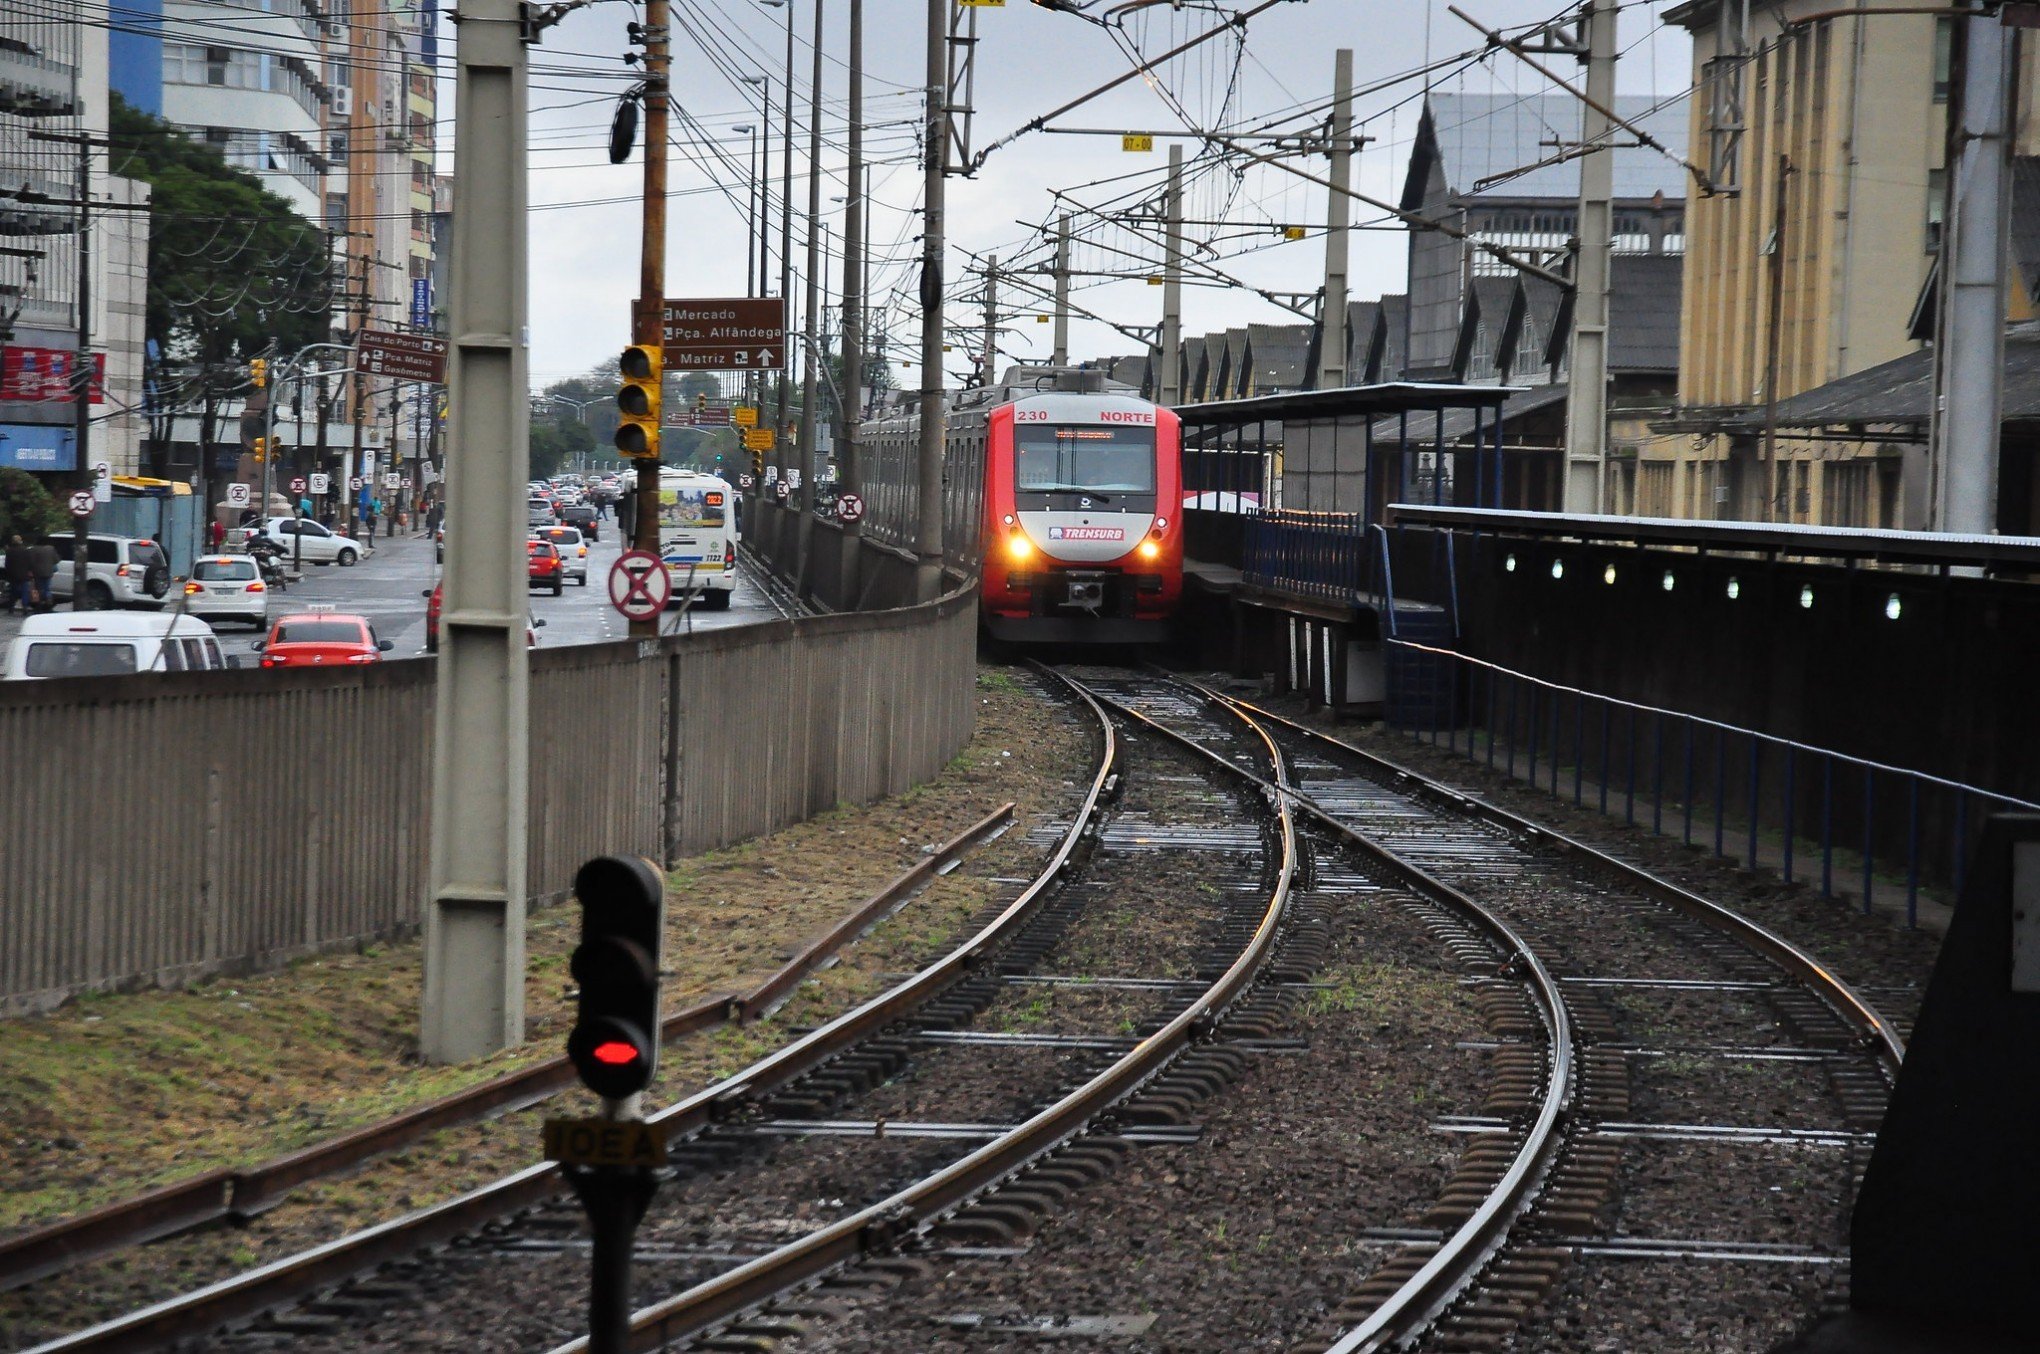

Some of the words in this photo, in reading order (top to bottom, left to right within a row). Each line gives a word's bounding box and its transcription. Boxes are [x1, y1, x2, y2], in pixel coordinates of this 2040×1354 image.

[675, 309, 736, 320] Mercado
[675, 327, 705, 341] Pça.
[710, 326, 781, 339] Alfândega
[363, 333, 382, 343] Cais
[383, 337, 395, 345] do
[396, 339, 420, 349] Porto
[405, 355, 432, 367] Matriz
[680, 353, 725, 364] Matriz
[1018, 411, 1048, 421] 230
[1100, 411, 1153, 423] NORTE
[1065, 528, 1123, 539] TRENSURB
